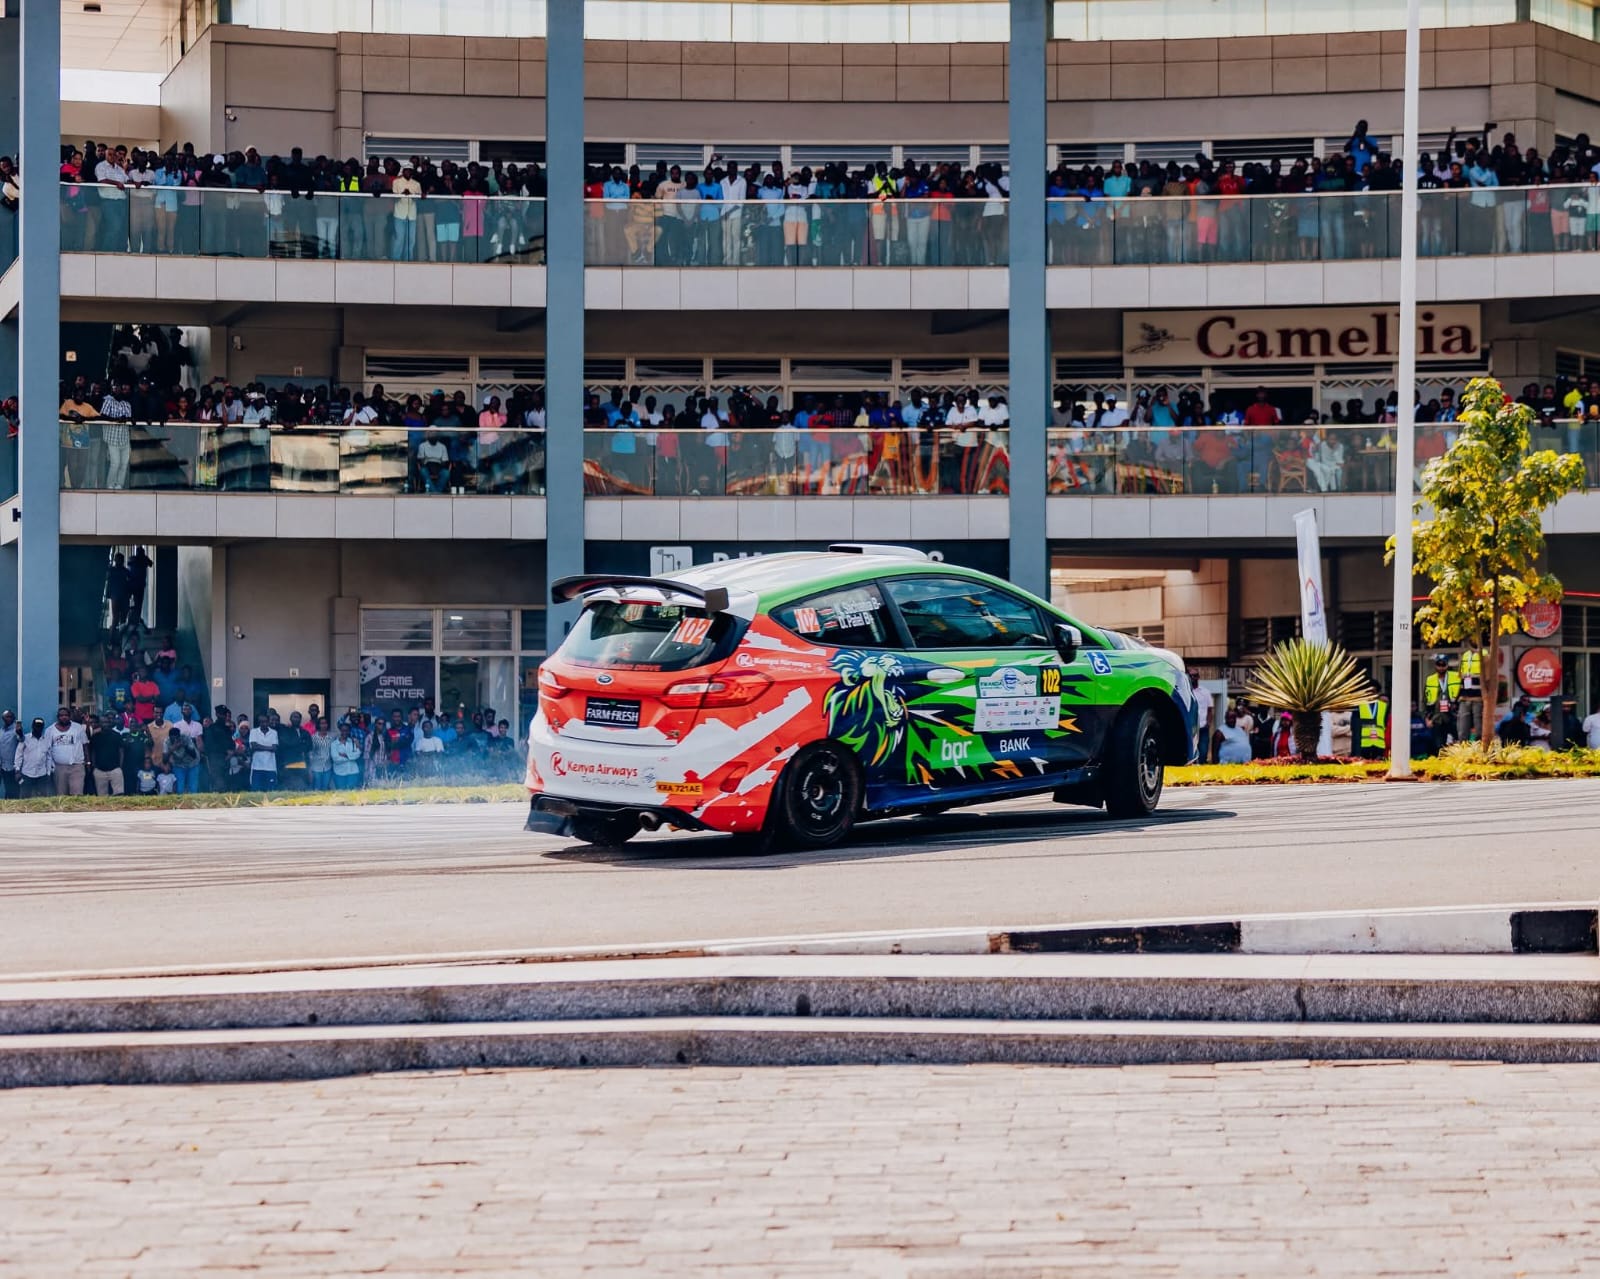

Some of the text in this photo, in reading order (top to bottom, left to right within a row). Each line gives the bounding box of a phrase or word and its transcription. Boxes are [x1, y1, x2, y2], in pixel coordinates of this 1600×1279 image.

[674, 617, 713, 645] 102
[379, 675, 413, 686] GAME
[1042, 669, 1060, 693] 102
[375, 688, 425, 699] CENTER
[587, 707, 639, 723] FARM FRESH
[941, 736, 1031, 766] bpr BANK
[567, 760, 638, 779] Kenya Airways
